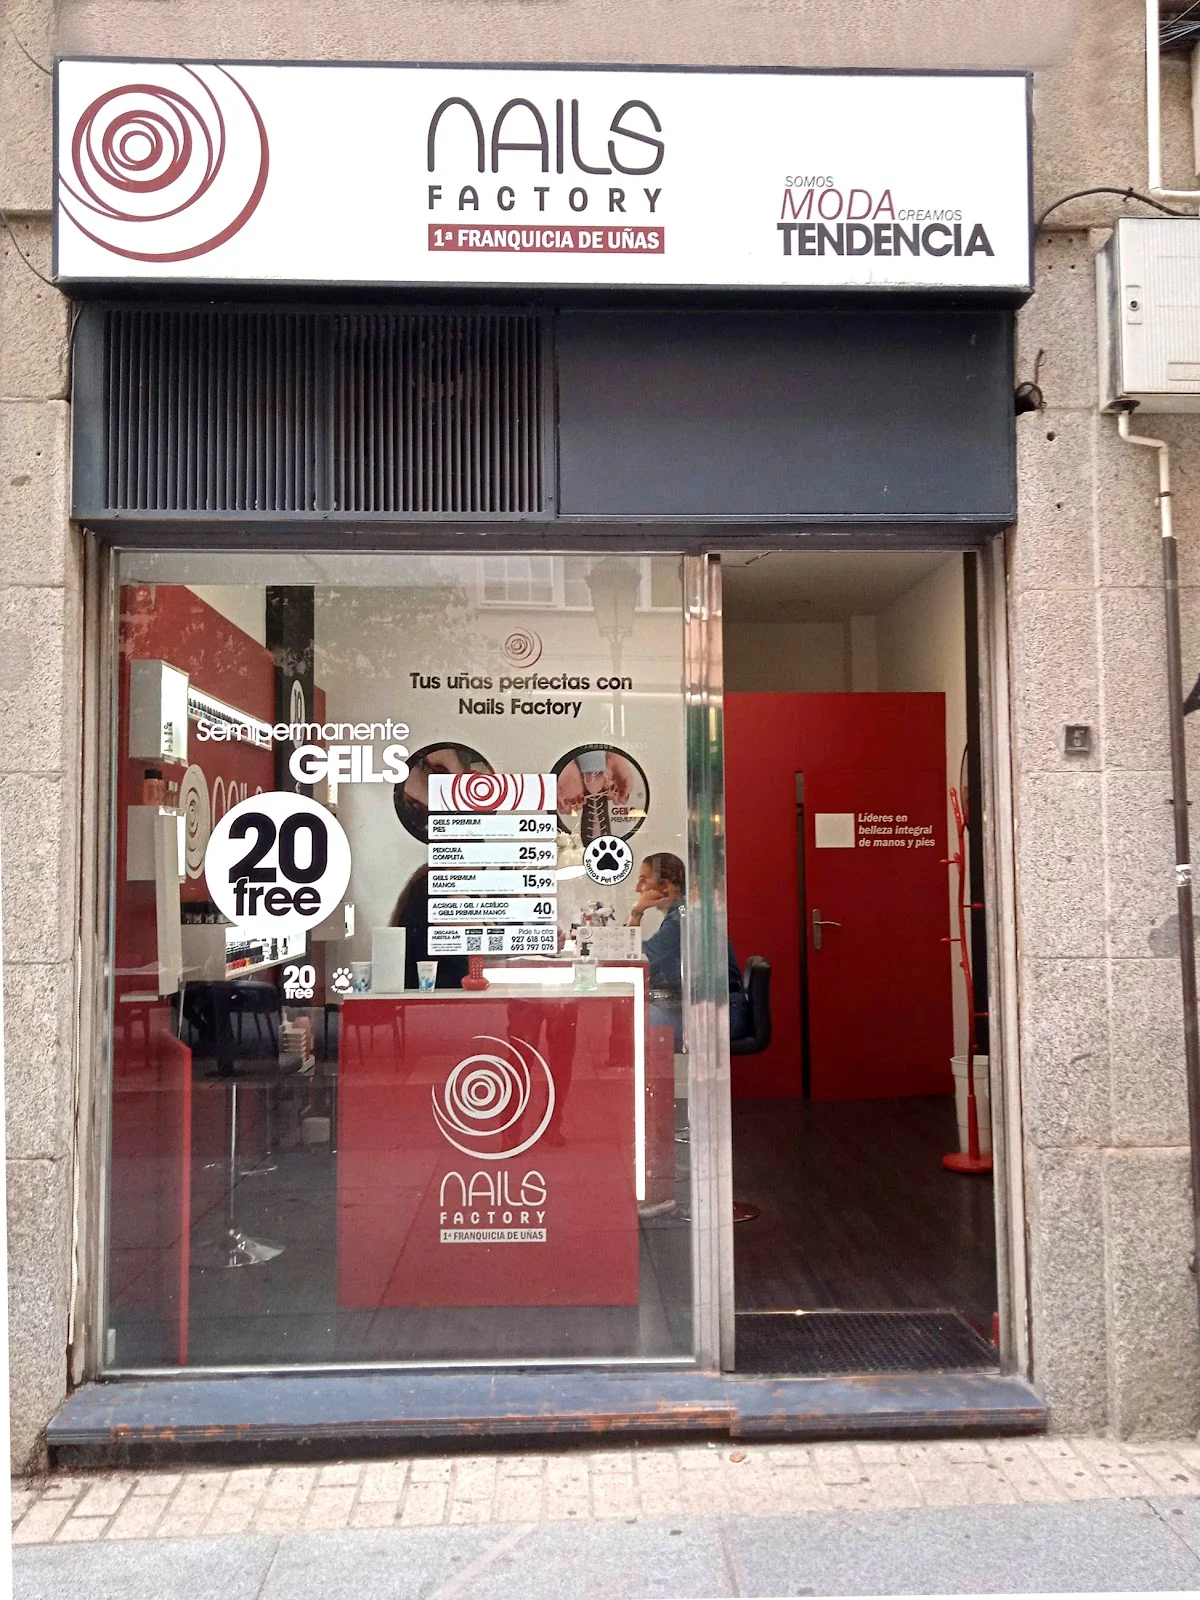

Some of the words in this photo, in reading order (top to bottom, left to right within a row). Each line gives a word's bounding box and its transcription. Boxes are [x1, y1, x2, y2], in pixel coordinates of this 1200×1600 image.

[427, 96, 665, 176] NAILS
[785, 175, 834, 188] SOMOS
[428, 184, 663, 213] FACTORY
[780, 188, 896, 221] MODA
[898, 209, 963, 221] CREAMOS
[433, 229, 453, 247] 1ª
[457, 229, 574, 250] FRANQUICIA
[578, 231, 604, 249] DE
[608, 228, 660, 250] UÑAS
[776, 222, 995, 257] TENDENCIA
[409, 672, 441, 689] Tus
[447, 673, 493, 689] uñas
[500, 672, 591, 693] perfectas
[596, 675, 633, 690] con
[458, 698, 505, 715] Nails
[511, 698, 582, 718] Factory
[196, 717, 410, 746] Semipermanente
[289, 743, 410, 785] GEILS
[452, 818, 481, 826] PREMIUM
[858, 812, 894, 822] Líderes
[895, 814, 908, 822] en
[858, 825, 893, 835] belleza
[895, 825, 933, 837] integral
[228, 811, 328, 884] 20
[858, 837, 872, 847] de
[873, 838, 906, 847] manos
[907, 839, 914, 849] y
[915, 837, 936, 849] pies
[585, 858, 599, 880] Somos
[613, 859, 632, 883] Friendly
[233, 877, 322, 917] free
[510, 943, 525, 951] 693
[526, 943, 540, 951] 797
[541, 943, 555, 951] 076
[511, 935, 525, 943] 927
[526, 935, 539, 943] 618
[540, 935, 554, 943] 043
[283, 964, 316, 989] 20
[284, 987, 314, 1000] free
[439, 1170, 547, 1207] NAILS
[439, 1210, 546, 1225] FACTORY
[453, 1231, 505, 1241] FRANQUICIA
[507, 1231, 519, 1240] DE
[520, 1230, 544, 1240] UÑAS
